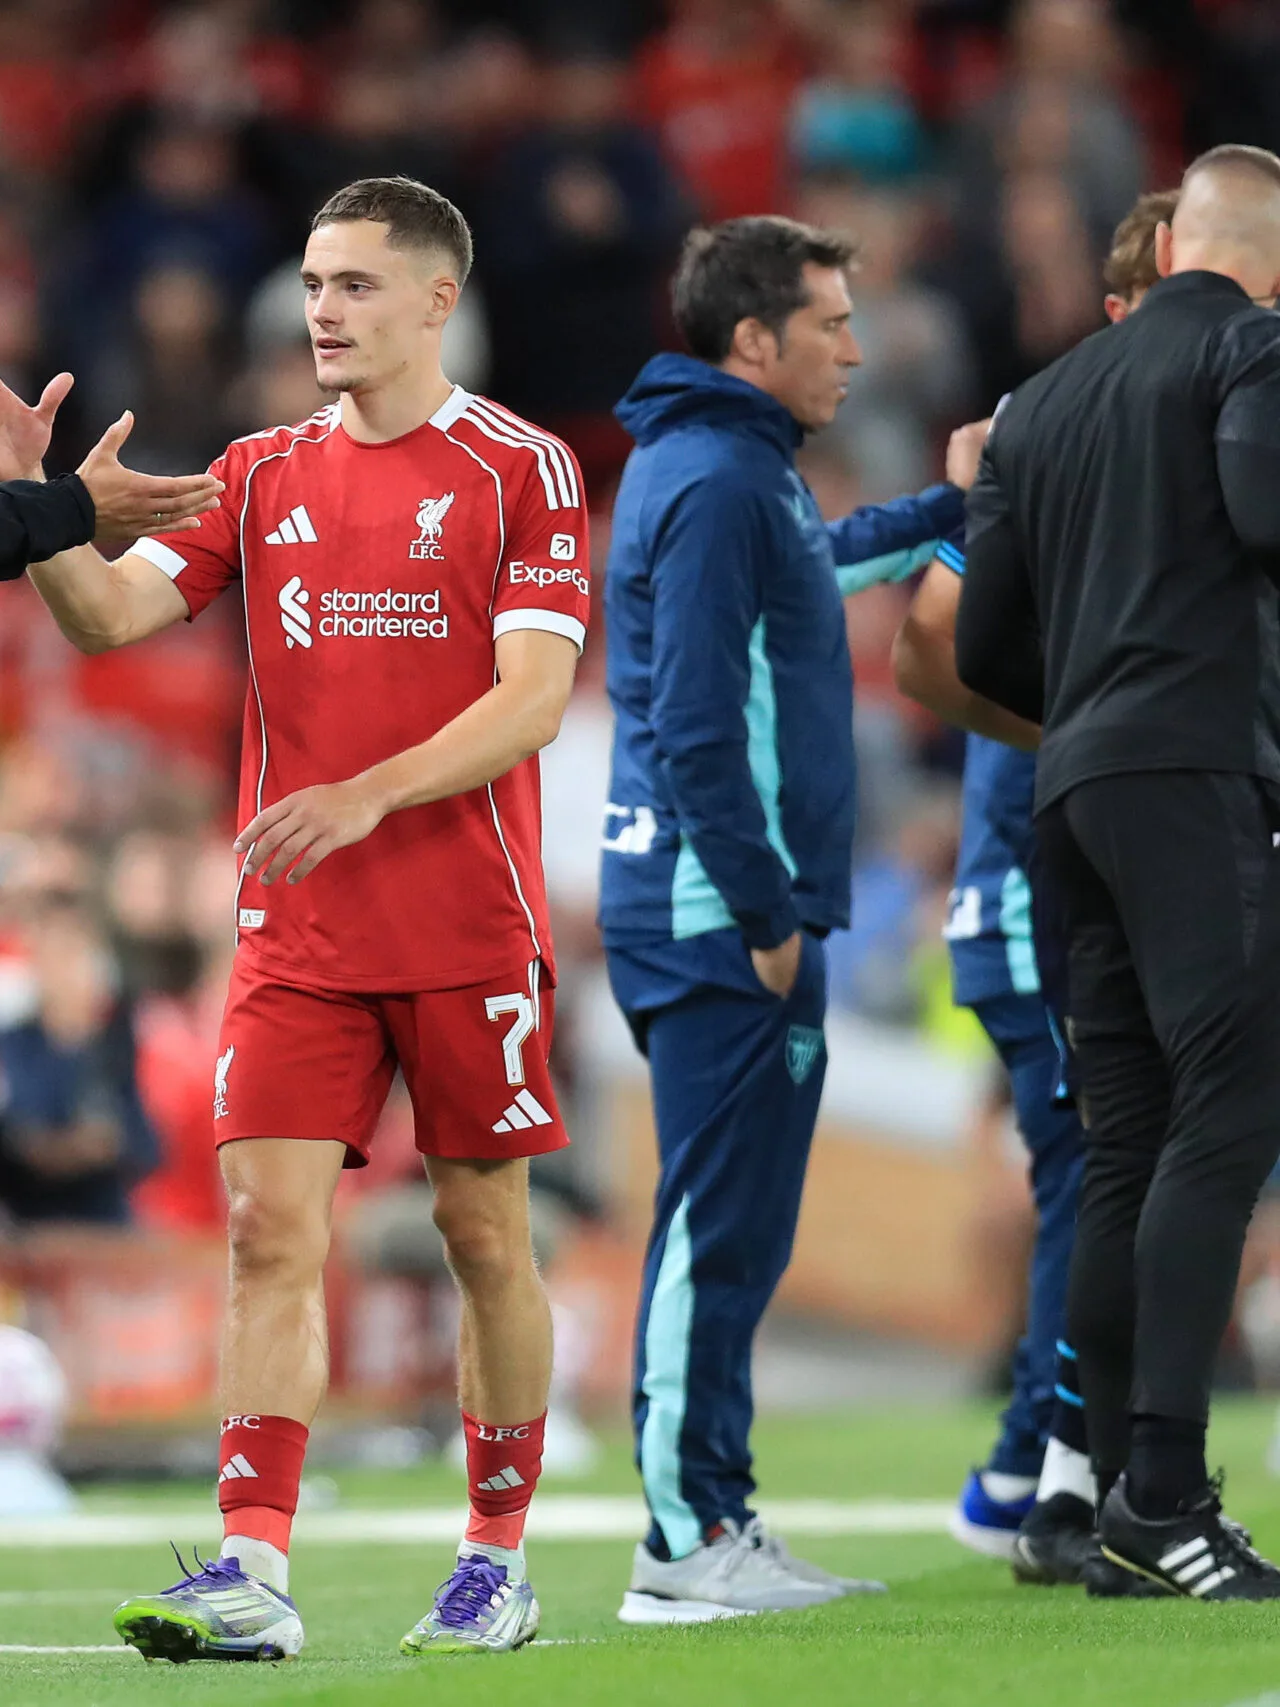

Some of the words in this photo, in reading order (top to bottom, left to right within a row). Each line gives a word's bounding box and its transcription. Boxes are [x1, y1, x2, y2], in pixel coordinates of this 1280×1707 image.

[319, 587, 440, 613] standard
[318, 612, 448, 639] chartered
[484, 992, 535, 1086] 7
[477, 1423, 530, 1442] LFC
